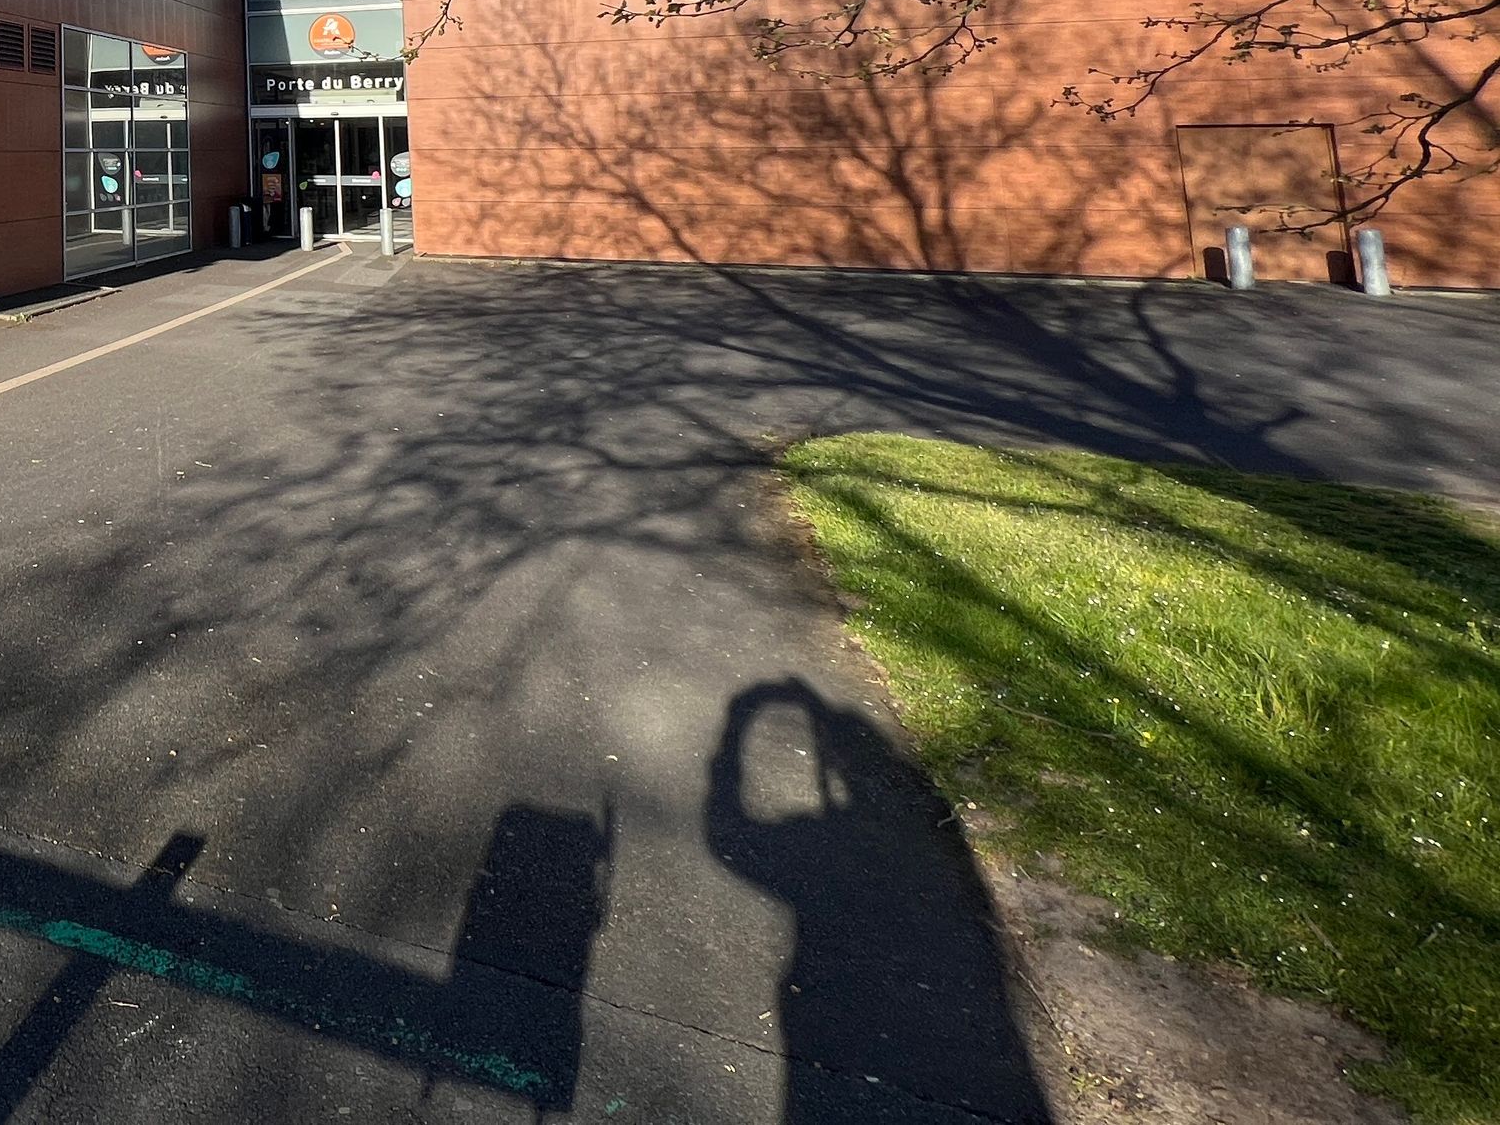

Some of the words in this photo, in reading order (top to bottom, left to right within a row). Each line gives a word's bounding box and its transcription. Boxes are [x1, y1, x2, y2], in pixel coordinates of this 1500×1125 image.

[266, 77, 314, 91] Porte
[321, 76, 343, 90] du
[350, 75, 404, 92] Berry
